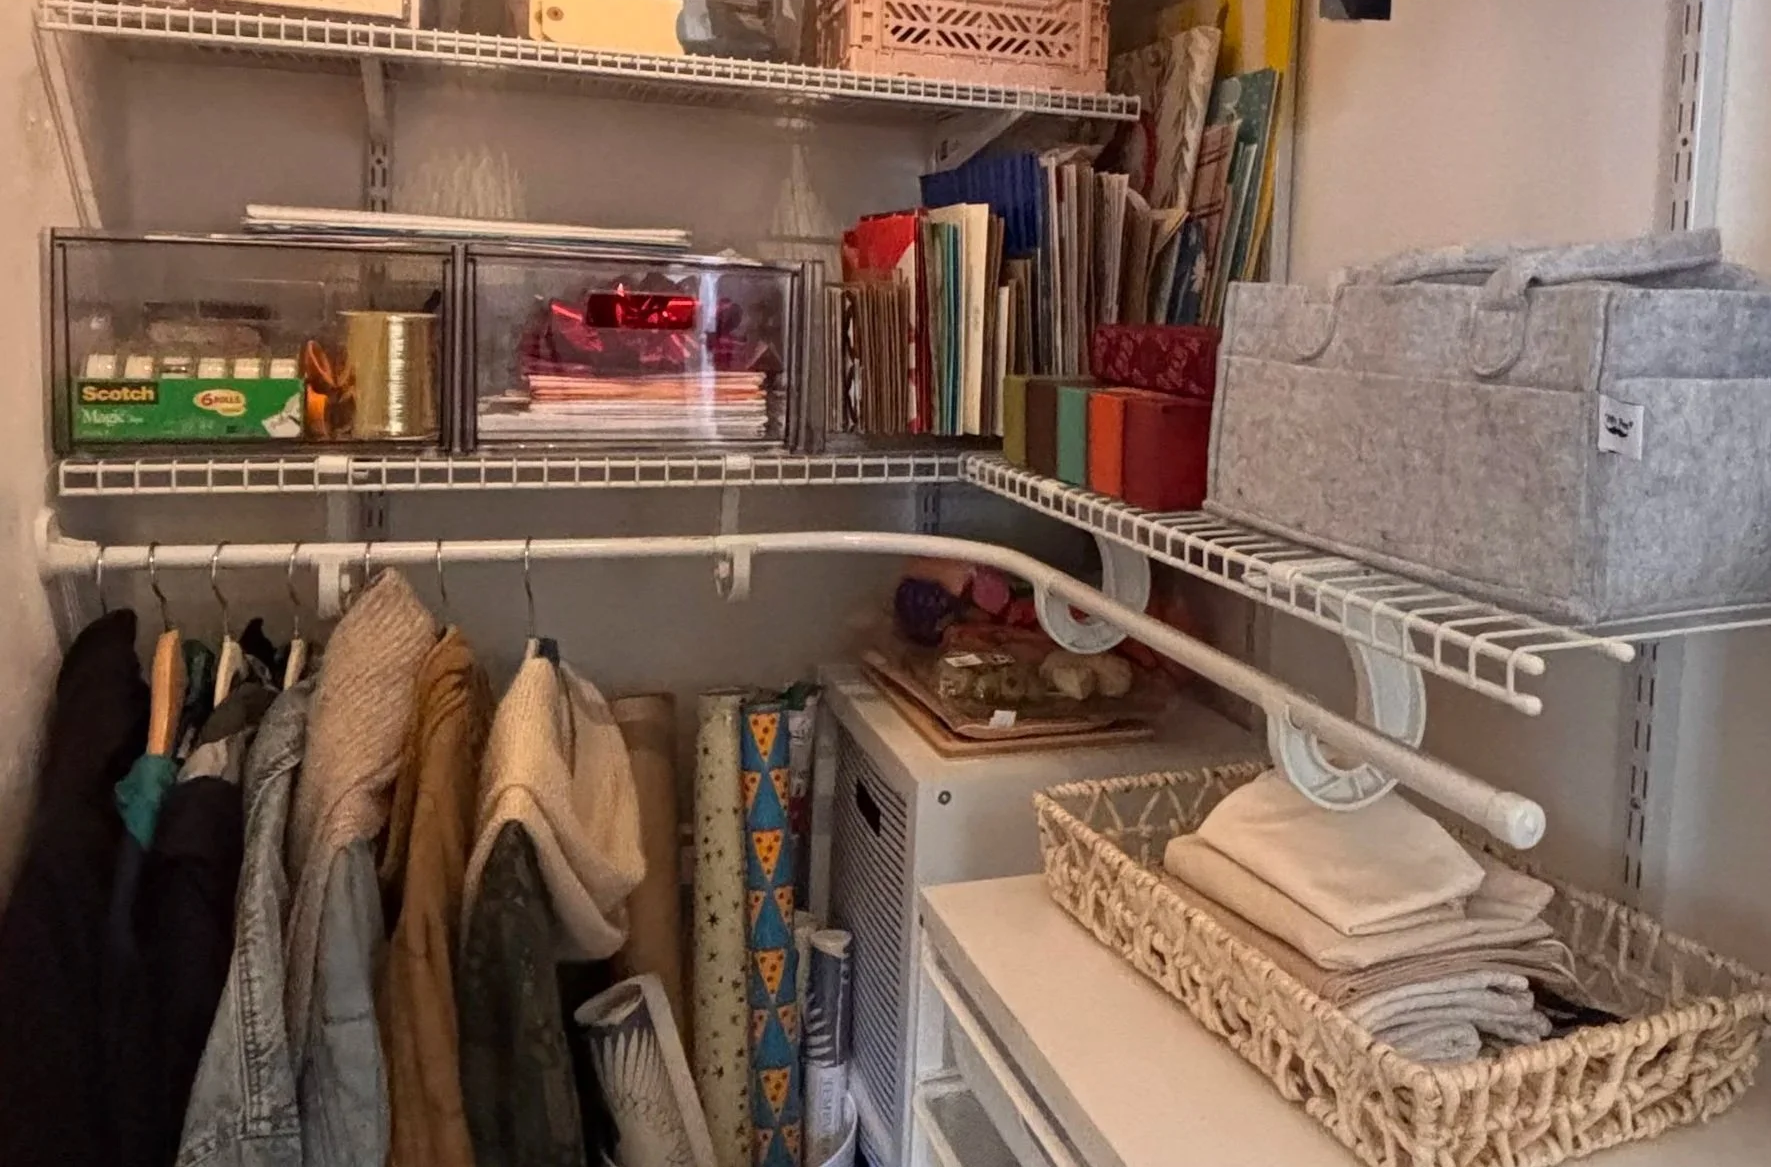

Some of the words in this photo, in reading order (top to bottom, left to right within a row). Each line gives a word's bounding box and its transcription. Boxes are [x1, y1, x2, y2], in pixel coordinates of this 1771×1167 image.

[81, 385, 155, 402] Scotch
[201, 393, 213, 407] 6
[81, 408, 125, 426] Magic
